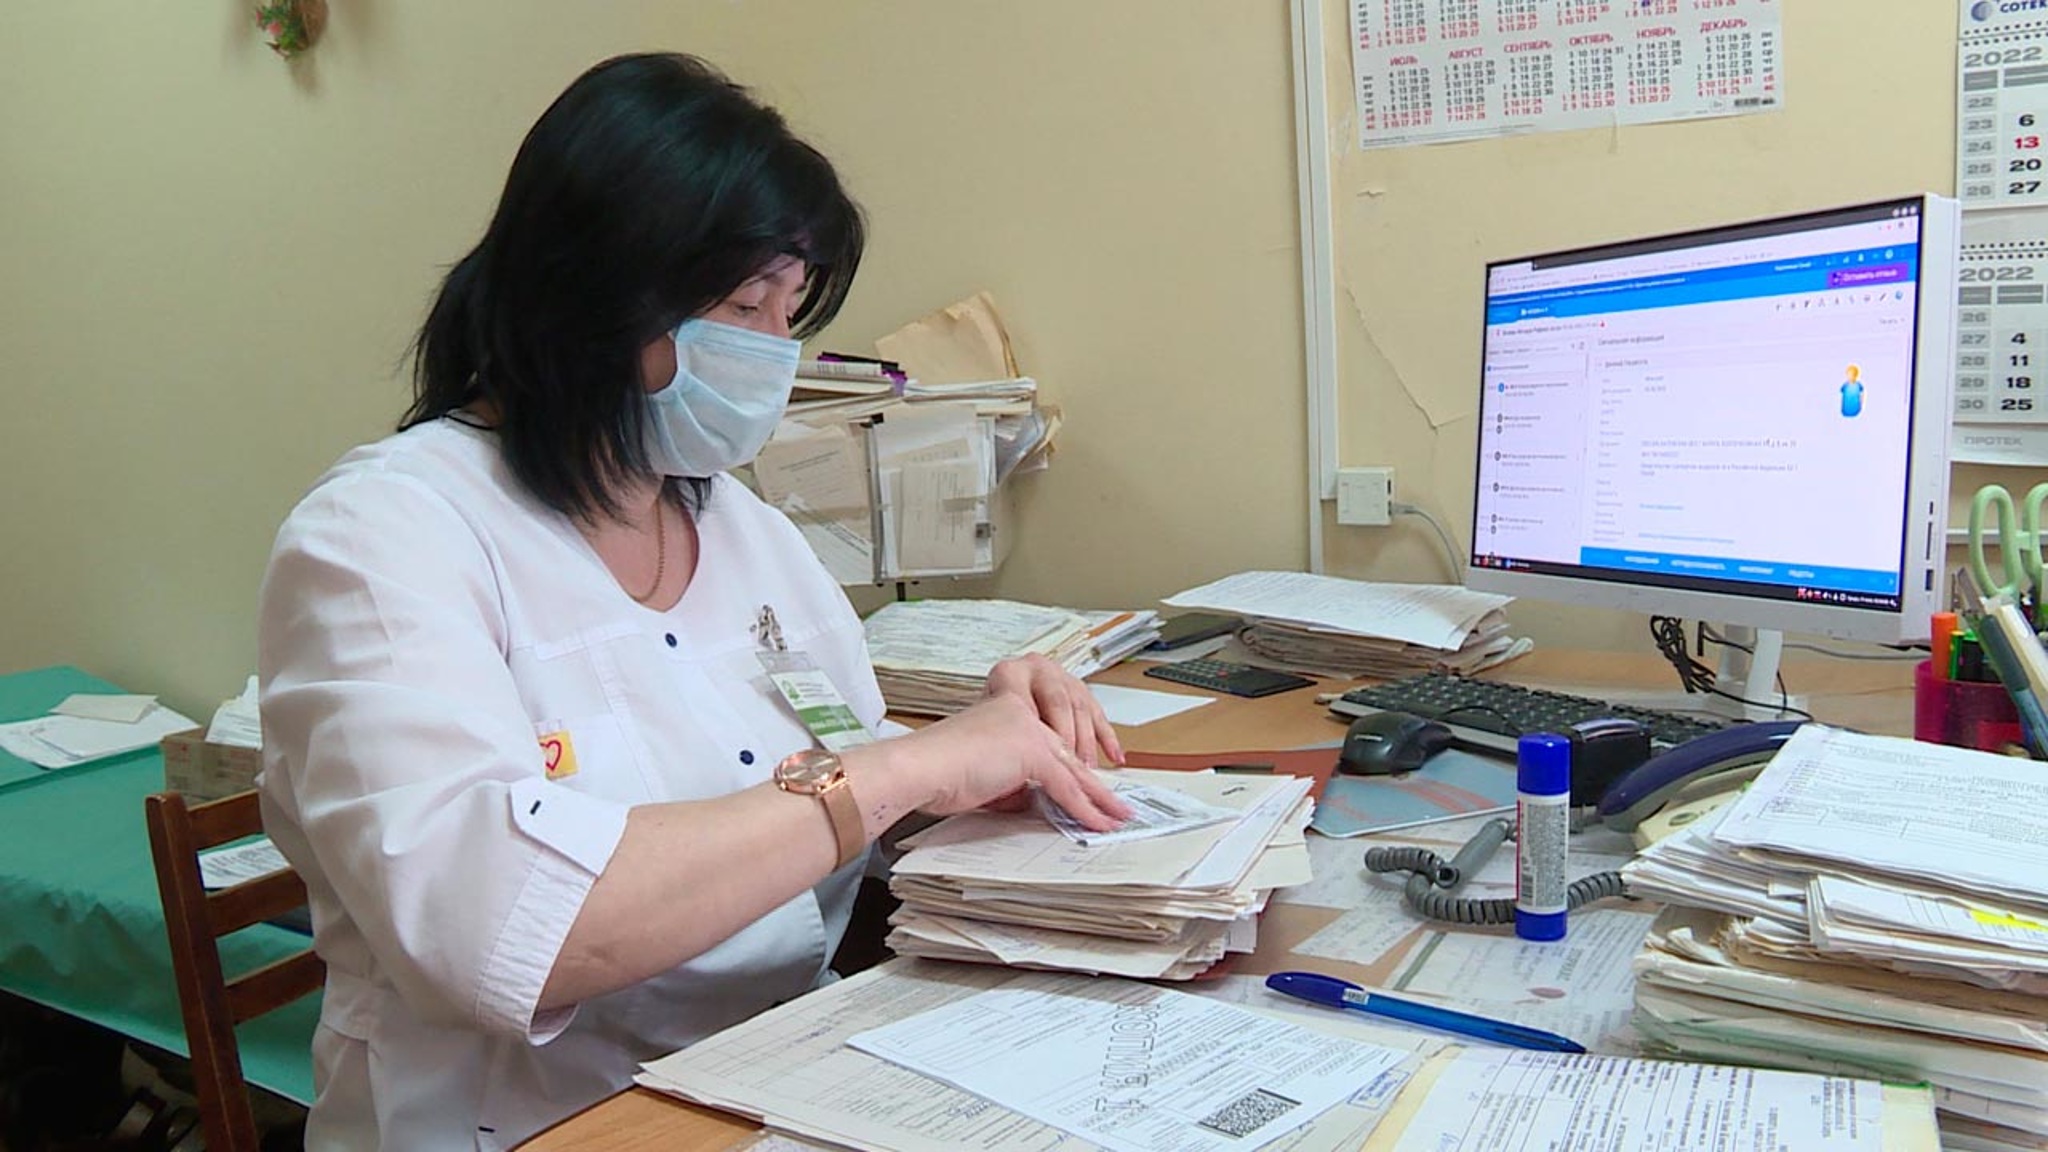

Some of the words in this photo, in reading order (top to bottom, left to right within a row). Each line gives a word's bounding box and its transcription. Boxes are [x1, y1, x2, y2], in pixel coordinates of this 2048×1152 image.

[1700, 18, 1748, 34] ДЕКАБРЬ
[1569, 33, 1614, 46] ОКТЯБРЬ
[1636, 27, 1676, 39] НОЯБРЬ
[1449, 47, 1483, 59] АВГУСТ
[1504, 40, 1553, 53] СЕНТЯБРЬ
[1964, 46, 2043, 68] 2022
[2018, 114, 2035, 127] 6
[2014, 136, 2040, 150] 13
[2009, 158, 2042, 173] 20
[2008, 180, 2042, 195] 27
[1958, 266, 2034, 283] 2022
[2010, 332, 2027, 344] 4
[2010, 355, 2029, 367] 11
[2006, 377, 2031, 389] 18
[2001, 398, 2033, 411] 25
[1964, 436, 2022, 446] ПРОТЕК
